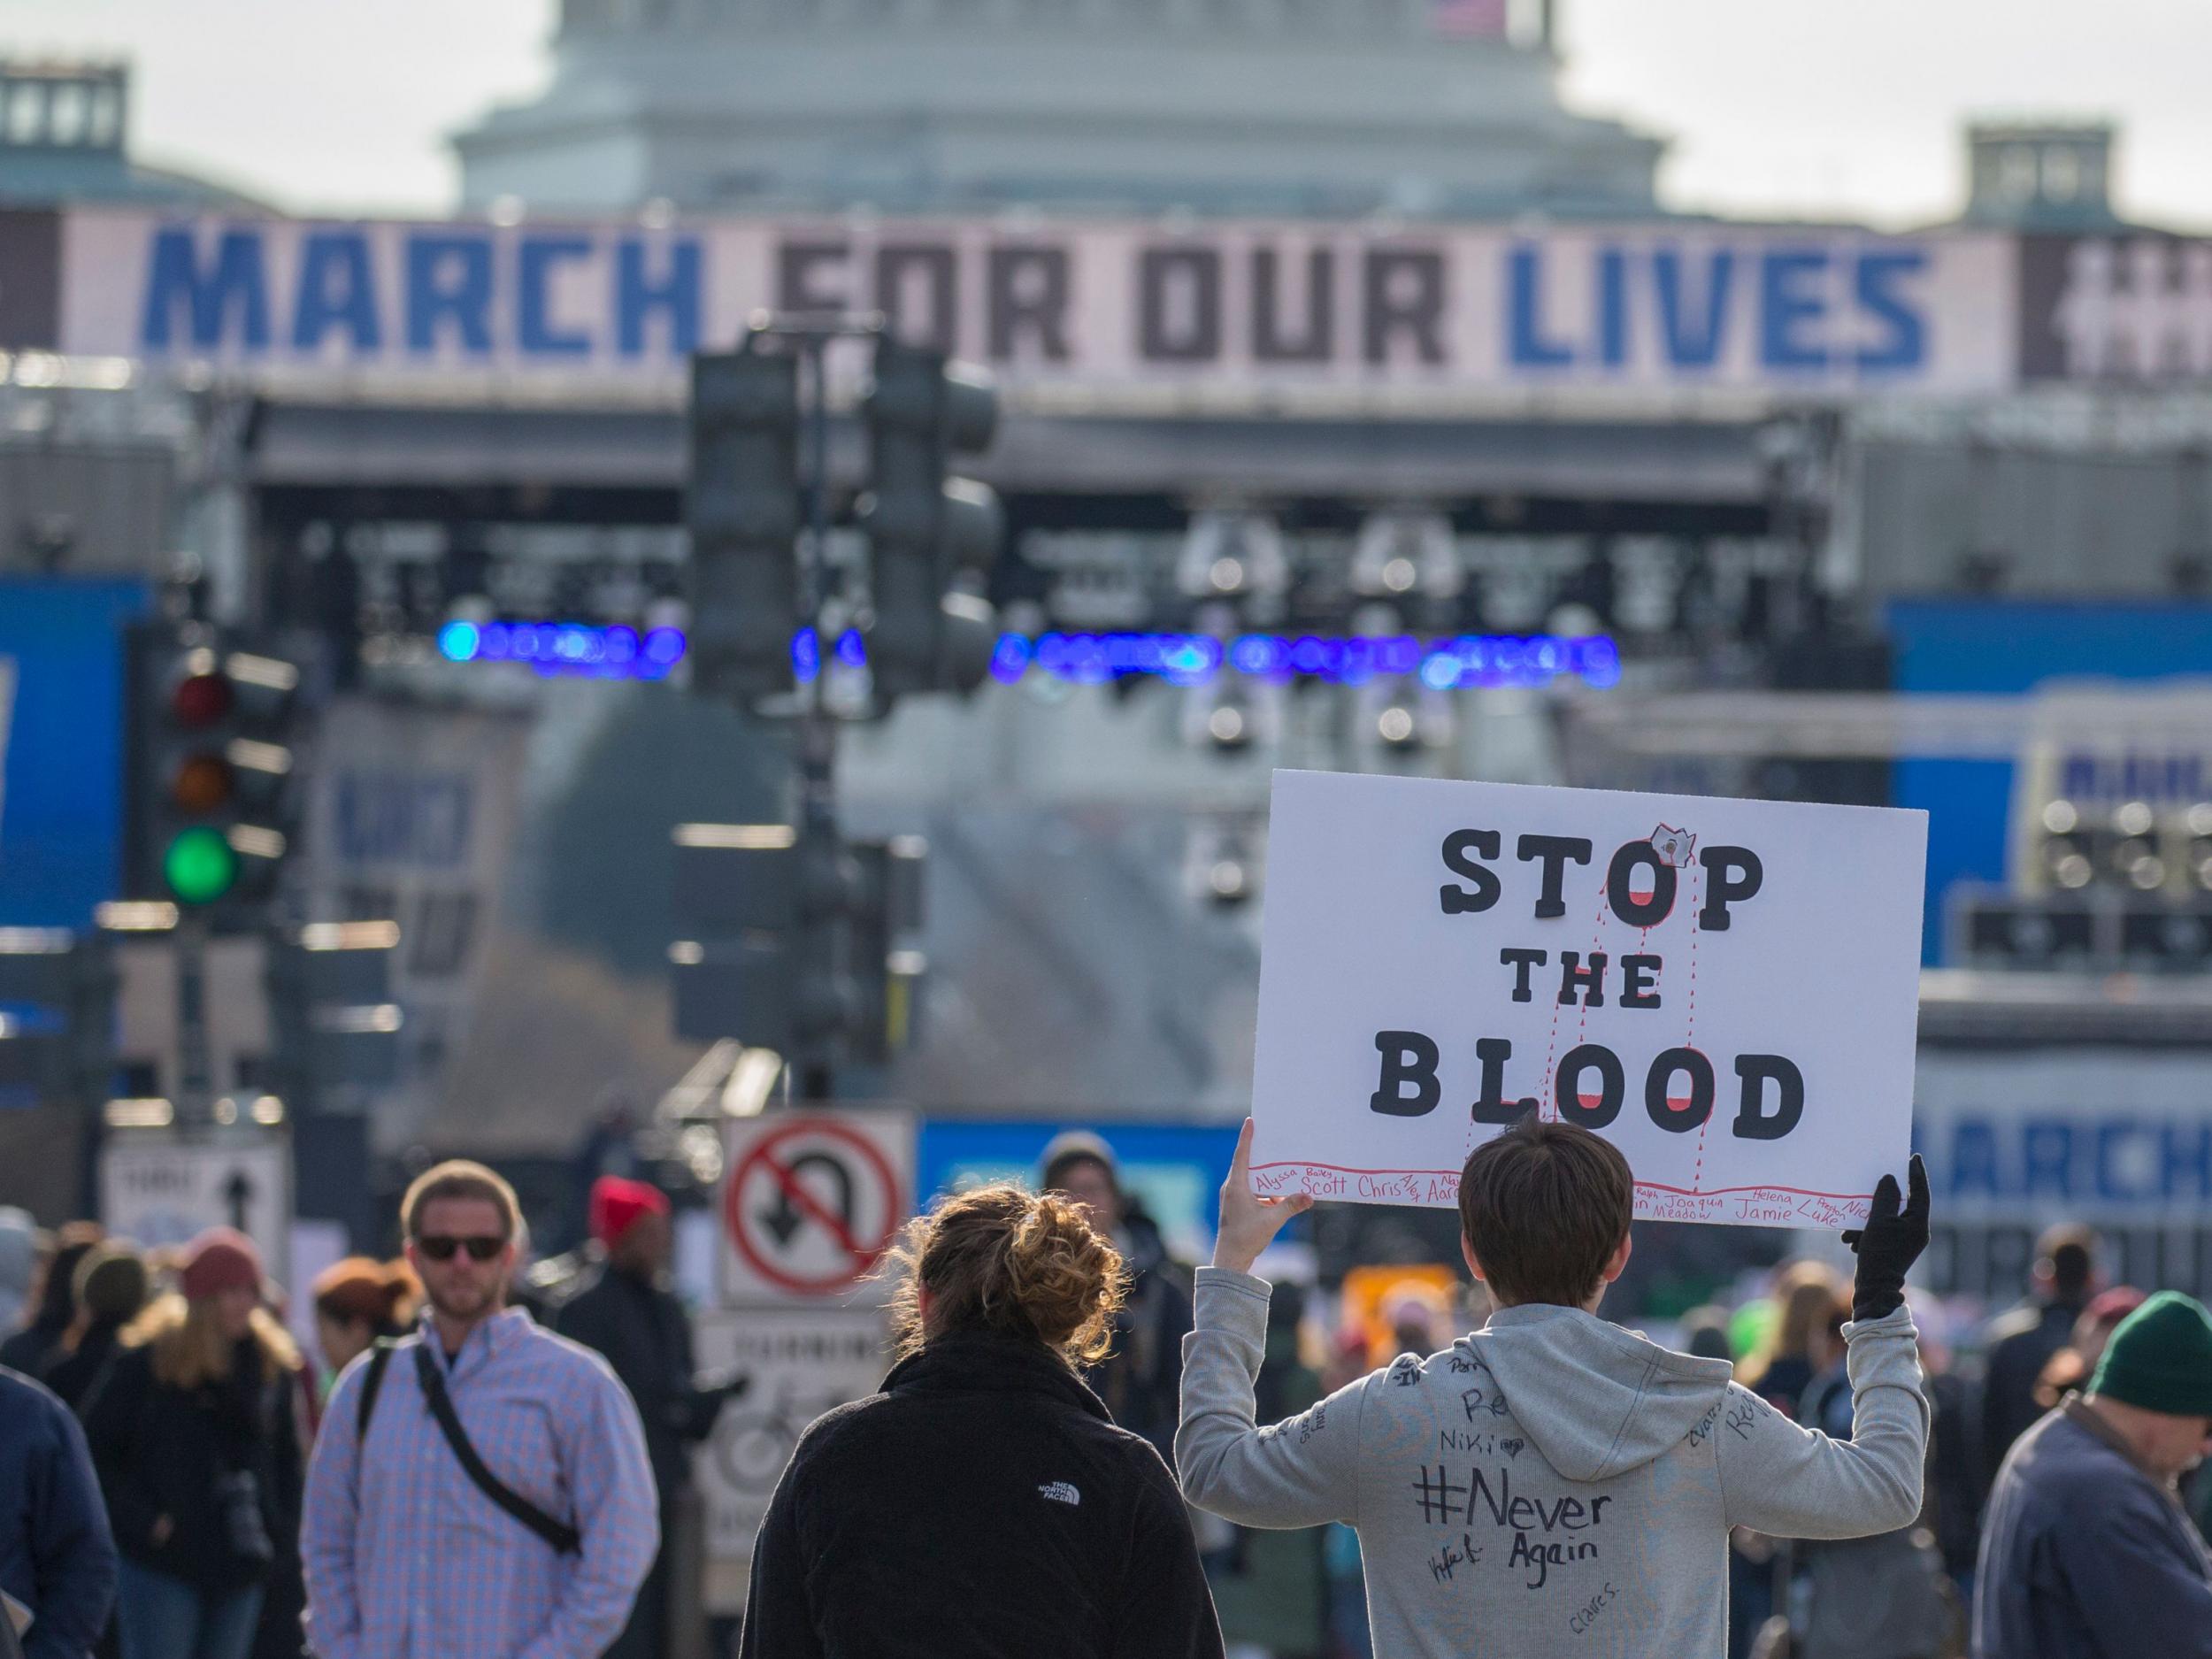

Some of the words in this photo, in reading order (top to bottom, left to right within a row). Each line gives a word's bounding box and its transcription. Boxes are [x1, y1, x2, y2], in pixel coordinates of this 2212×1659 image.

[140, 227, 704, 356] MARCH
[779, 242, 1072, 359] FOR
[1141, 248, 1448, 368] OUR
[1503, 245, 1932, 367] LIVES
[1440, 828, 1763, 931] STOP
[1501, 948, 1663, 1010] THE
[1370, 1031, 1805, 1141] BLOOD
[1256, 1169, 1298, 1192] Alyssa
[1301, 1176, 1348, 1195] Scott
[1358, 1175, 1402, 1198] Chris
[1912, 1113, 2212, 1200] ARCH
[1652, 1204, 1712, 1219] Meadow
[1734, 1198, 1793, 1221] Jamie
[1797, 1198, 1839, 1228] Luke
[1753, 1188, 1793, 1205] Helena
[1038, 1485, 1067, 1494] NORTH
[1044, 1492, 1066, 1502] FACE
[1411, 1464, 1613, 1532] #Never
[1509, 1532, 1598, 1589] Again
